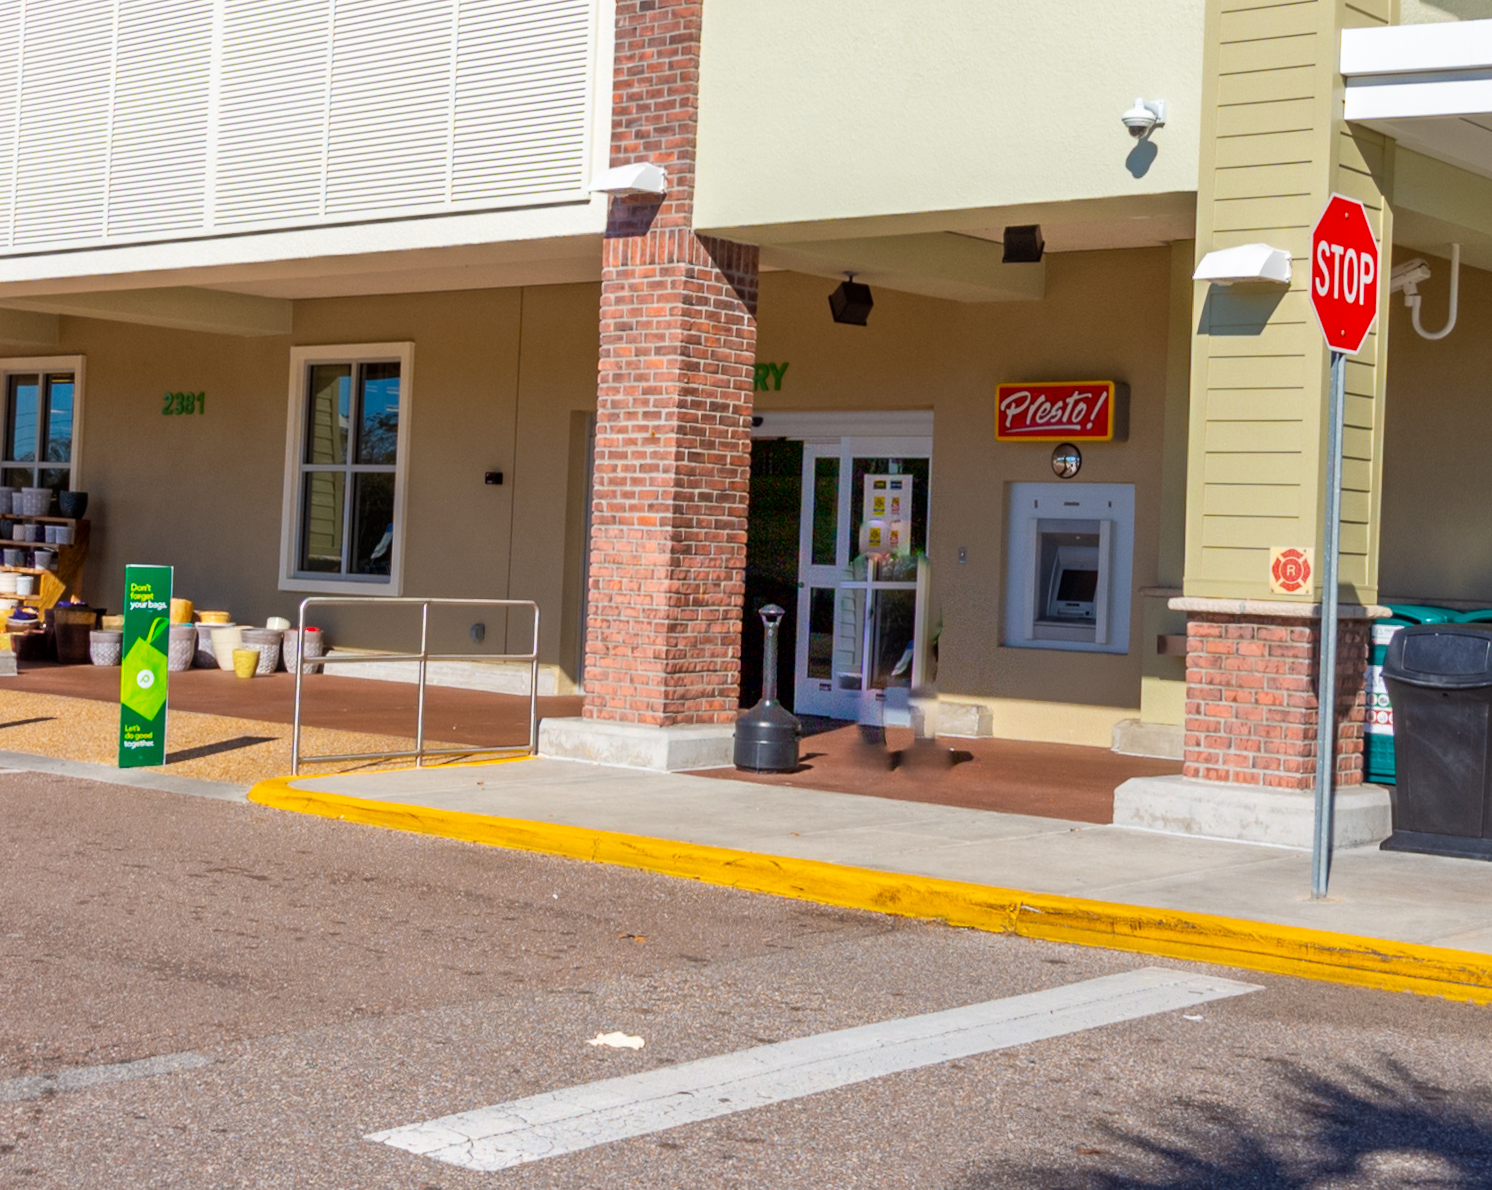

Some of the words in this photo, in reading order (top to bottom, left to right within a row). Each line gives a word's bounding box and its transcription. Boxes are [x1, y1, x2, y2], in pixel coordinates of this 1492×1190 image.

[1315, 240, 1374, 306] STOP
[161, 392, 205, 415] 2381
[1000, 391, 1107, 430] Presto!
[1287, 565, 1296, 576] R
[131, 583, 151, 591] Don't
[130, 592, 154, 602] forget
[130, 602, 147, 610] your
[148, 600, 167, 610] bags.
[135, 732, 153, 741] good
